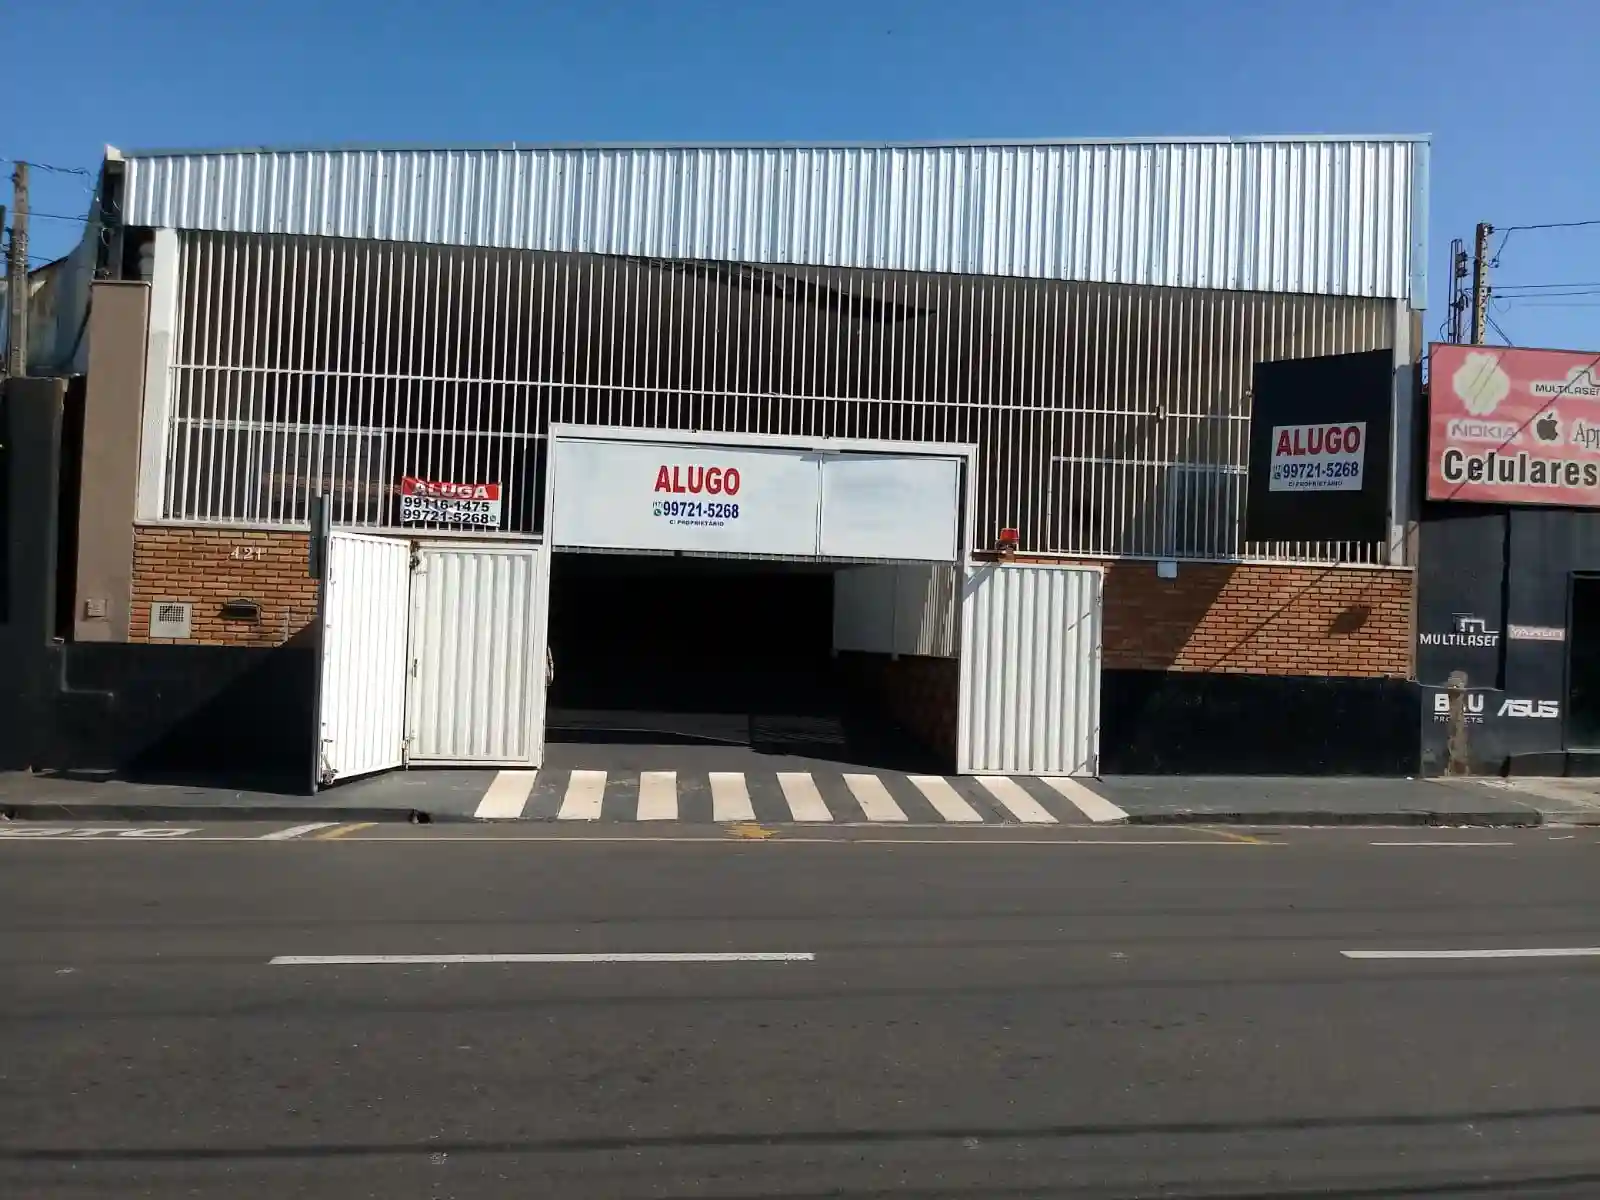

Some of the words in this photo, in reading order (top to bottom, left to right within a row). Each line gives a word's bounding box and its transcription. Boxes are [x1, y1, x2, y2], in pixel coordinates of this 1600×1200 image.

[1451, 423, 1517, 439] NOKIA
[1276, 426, 1361, 456] ALUGO
[1283, 461, 1359, 478] 99721-5268
[1444, 450, 1597, 486] Celulares
[654, 465, 740, 495] ALUGO
[404, 496, 489, 511] 99116-1475
[663, 501, 739, 519] 99721-5268
[403, 509, 489, 524] 99721-5268
[230, 546, 261, 561] 421
[1434, 693, 1484, 713] BU
[1497, 699, 1559, 718] ASUS
